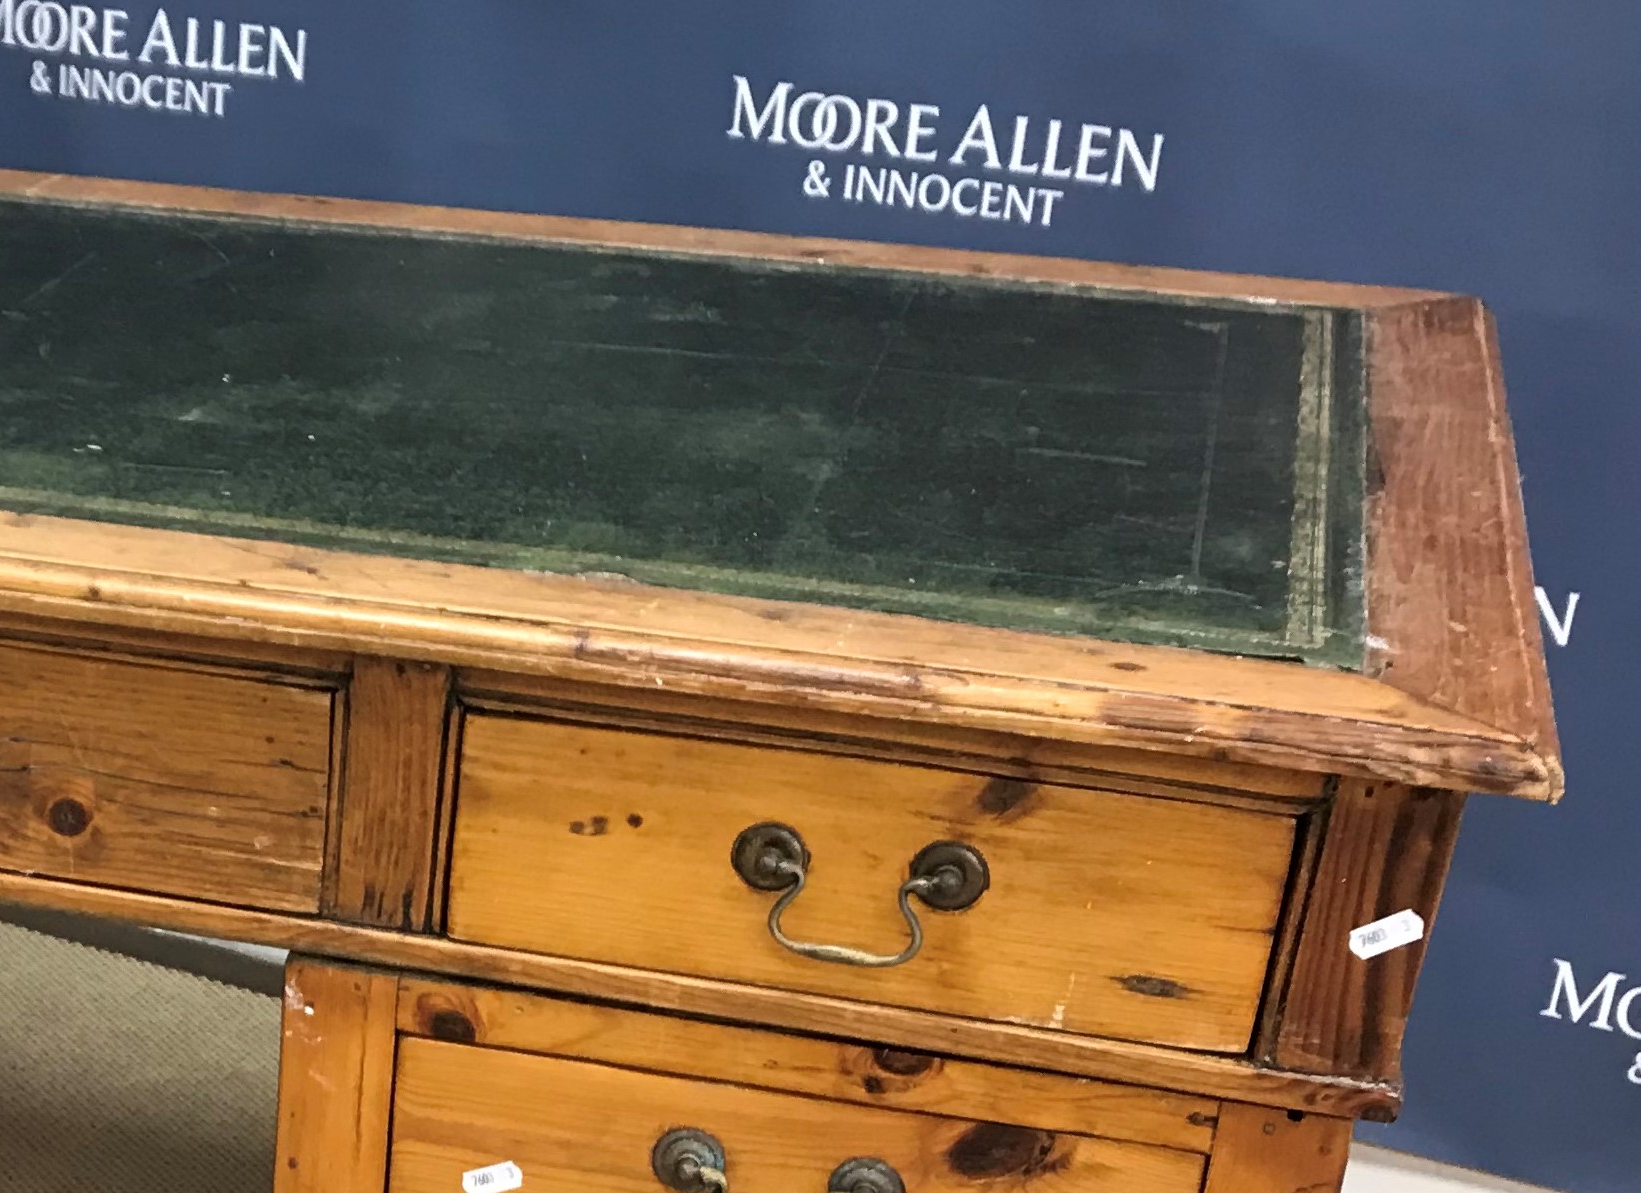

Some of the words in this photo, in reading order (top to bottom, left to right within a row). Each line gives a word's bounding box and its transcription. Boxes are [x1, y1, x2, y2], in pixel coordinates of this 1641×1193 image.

[138, 8, 306, 81] ALLEN
[30, 59, 52, 94] &
[59, 63, 231, 118] INNOCENT
[726, 75, 940, 161] MOORE
[949, 104, 1165, 192] ALLEN
[802, 159, 830, 197] &
[843, 164, 1064, 227] INNOCENT
